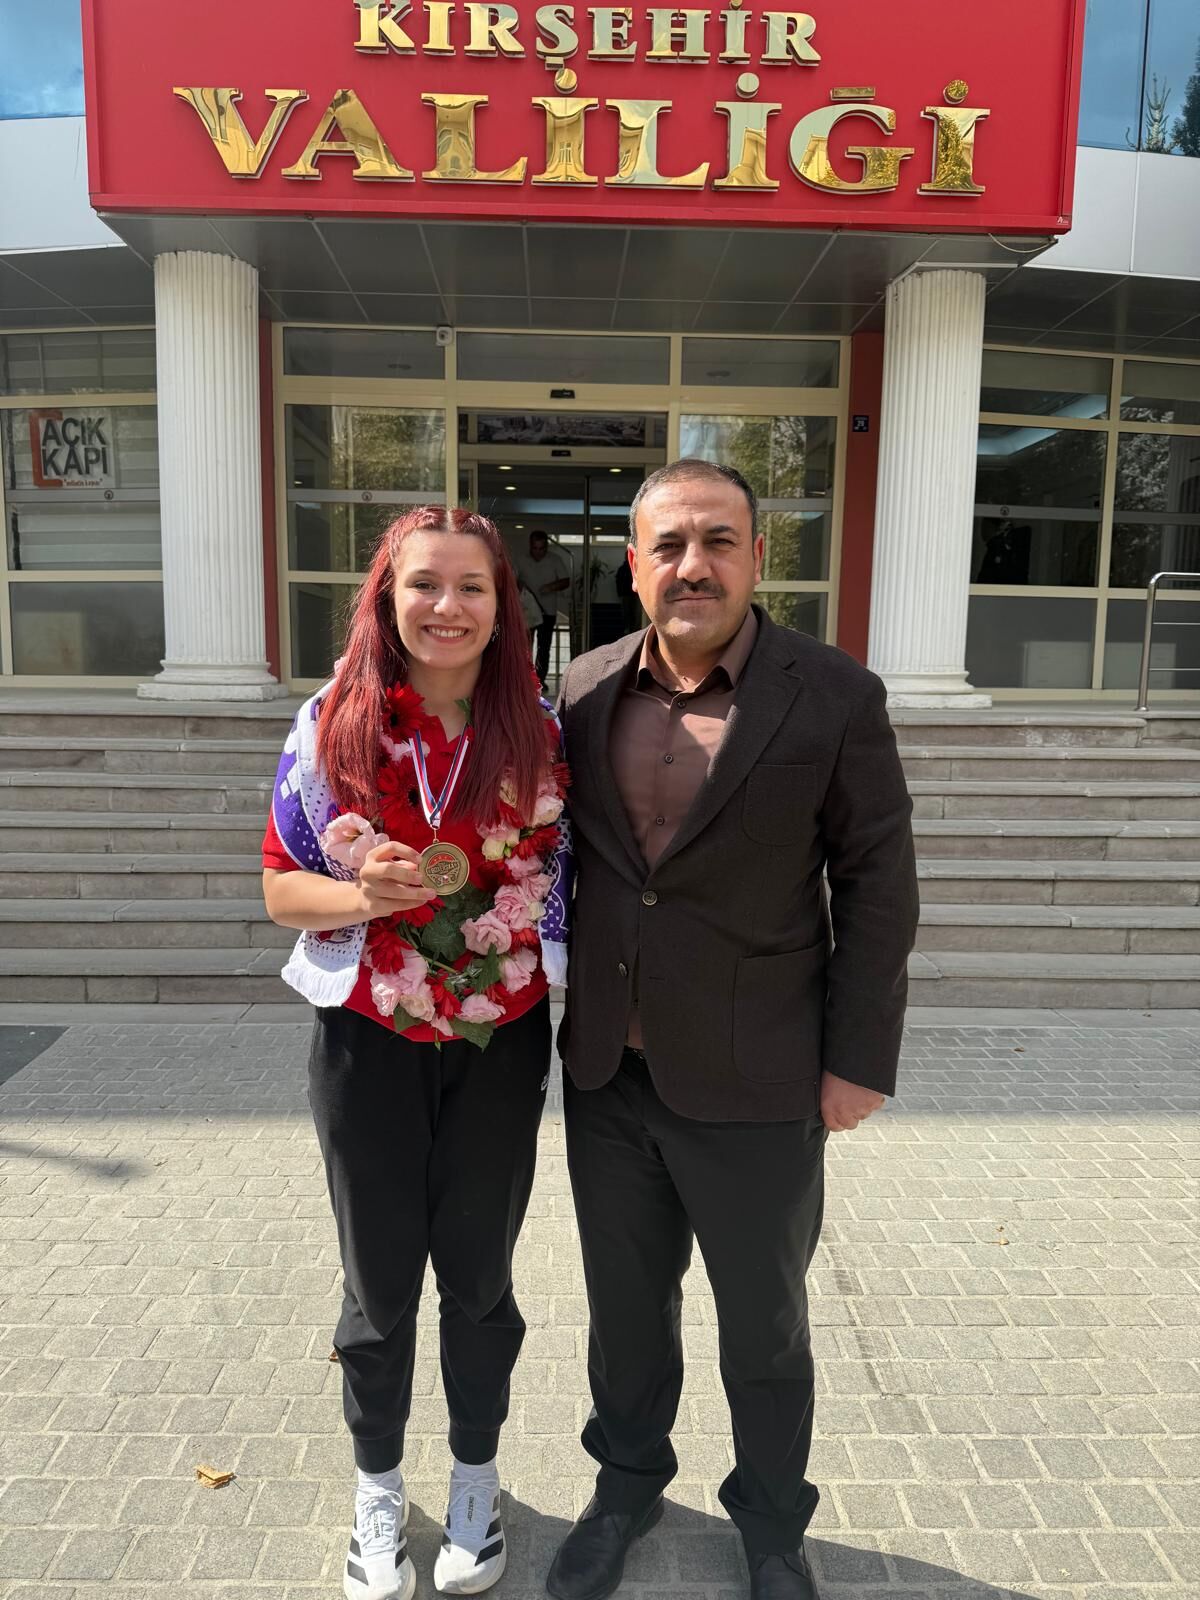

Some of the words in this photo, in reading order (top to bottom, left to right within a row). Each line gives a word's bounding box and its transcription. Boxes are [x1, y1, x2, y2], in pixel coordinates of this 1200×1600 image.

[354, 0, 822, 69] KIRŞEHİR
[172, 67, 991, 196] VALİLİĞİ
[42, 417, 106, 447] AÇIK
[42, 447, 108, 476] KAPI
